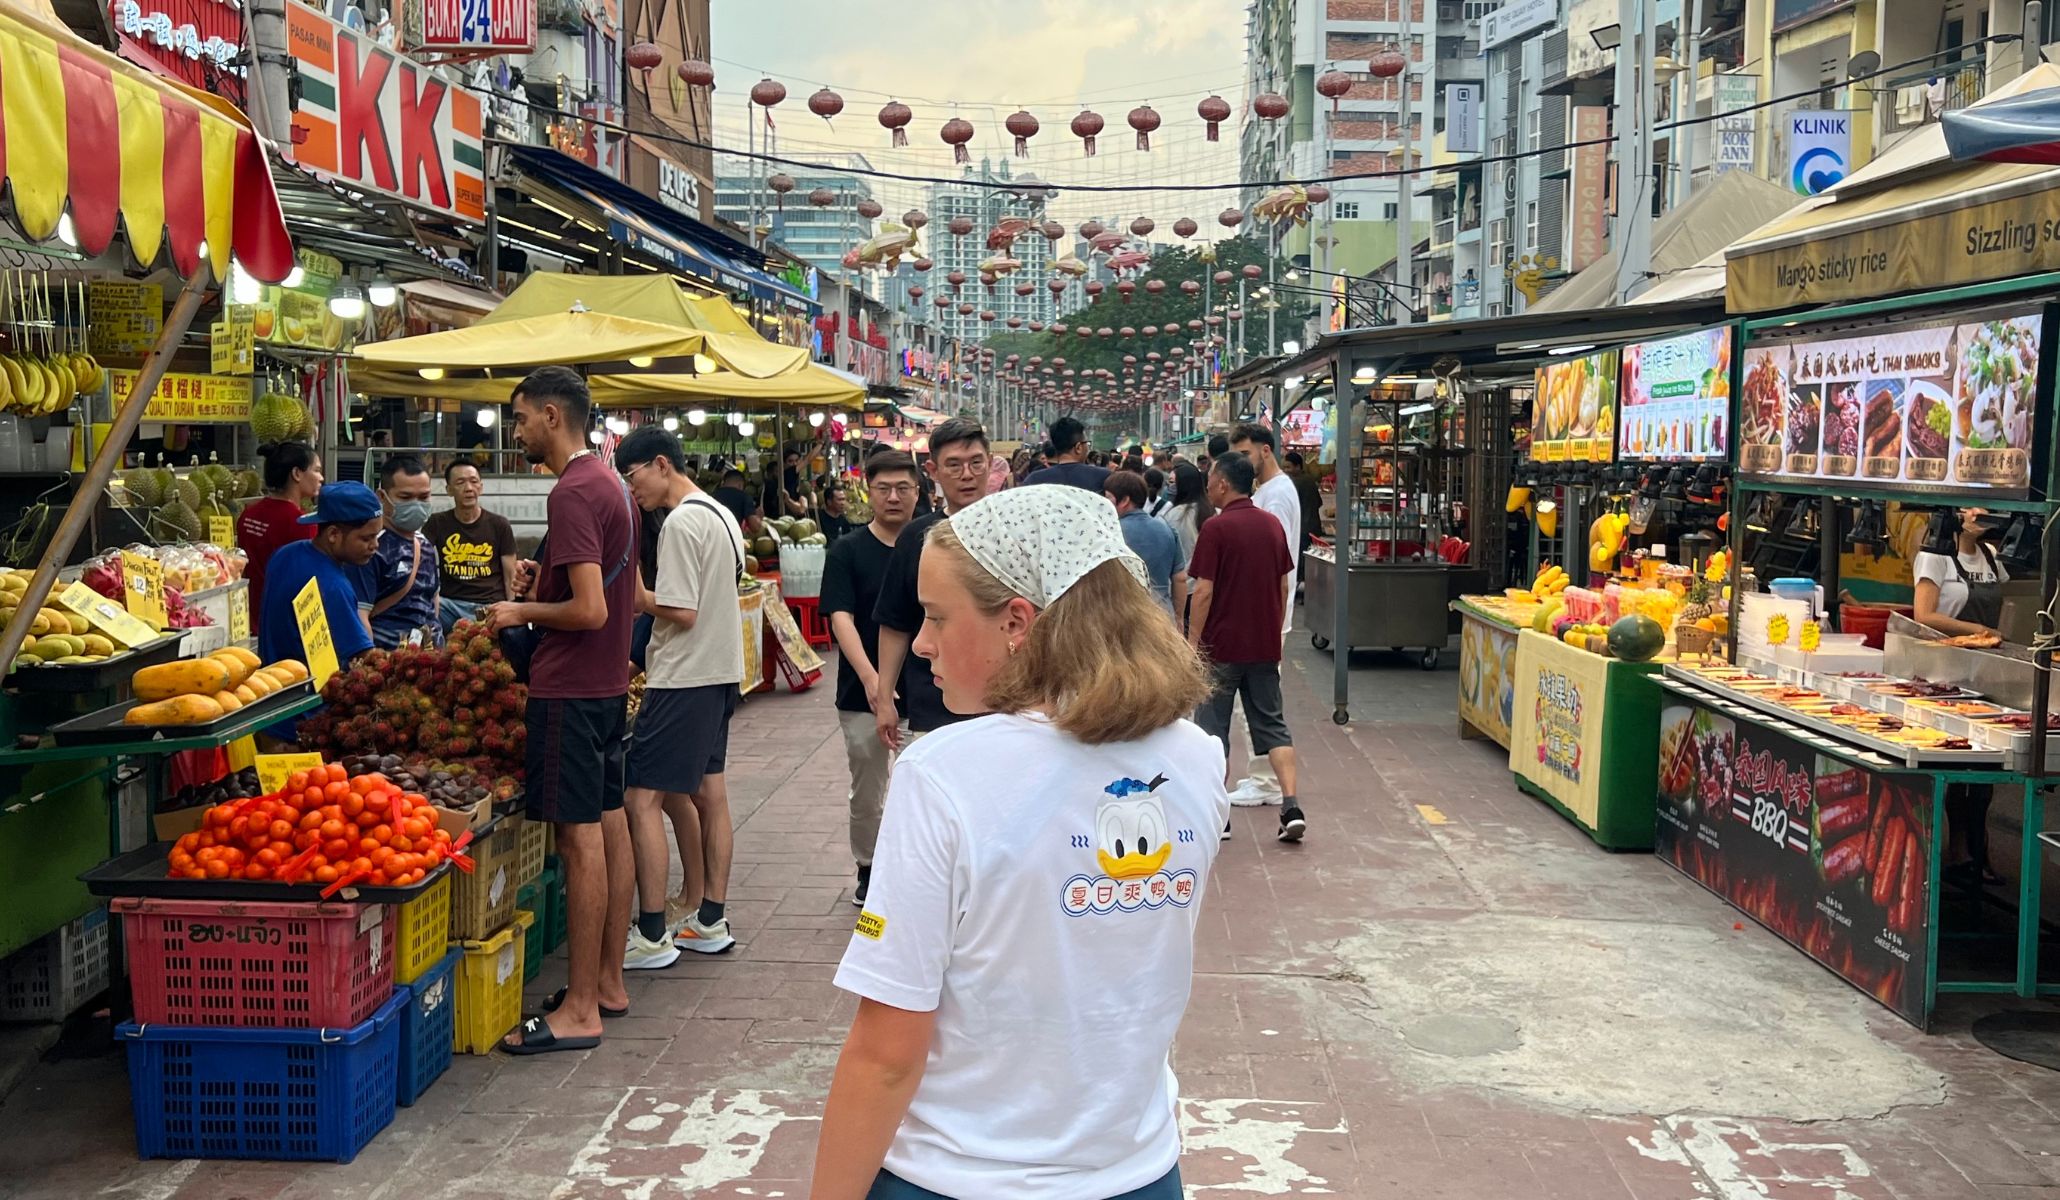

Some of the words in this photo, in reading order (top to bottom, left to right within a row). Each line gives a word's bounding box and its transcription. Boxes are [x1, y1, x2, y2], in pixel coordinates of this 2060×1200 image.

[461, 0, 491, 42] 24
[290, 24, 315, 46] PASAR
[316, 36, 332, 54] MINI
[337, 29, 452, 209] KK
[1721, 117, 1752, 131] YEW
[1793, 119, 1846, 135] KLINIK
[1721, 147, 1749, 160] ANN
[1722, 132, 1750, 146] KOK
[1580, 187, 1599, 267] GALAXY
[1965, 219, 2036, 256] Sizzling
[1777, 263, 1816, 289] Mango
[1818, 255, 1856, 283] sticky
[1859, 248, 1887, 274] rice
[1882, 356, 1902, 373] THAI
[1904, 351, 1941, 371] SNACKS
[149, 401, 173, 416] QUALITY
[174, 402, 195, 417] DURIAN
[442, 533, 494, 563] Super
[135, 577, 145, 592] 12
[1751, 797, 1788, 850] BBQ
[1070, 879, 1192, 907] 夏日爽鸭鸭
